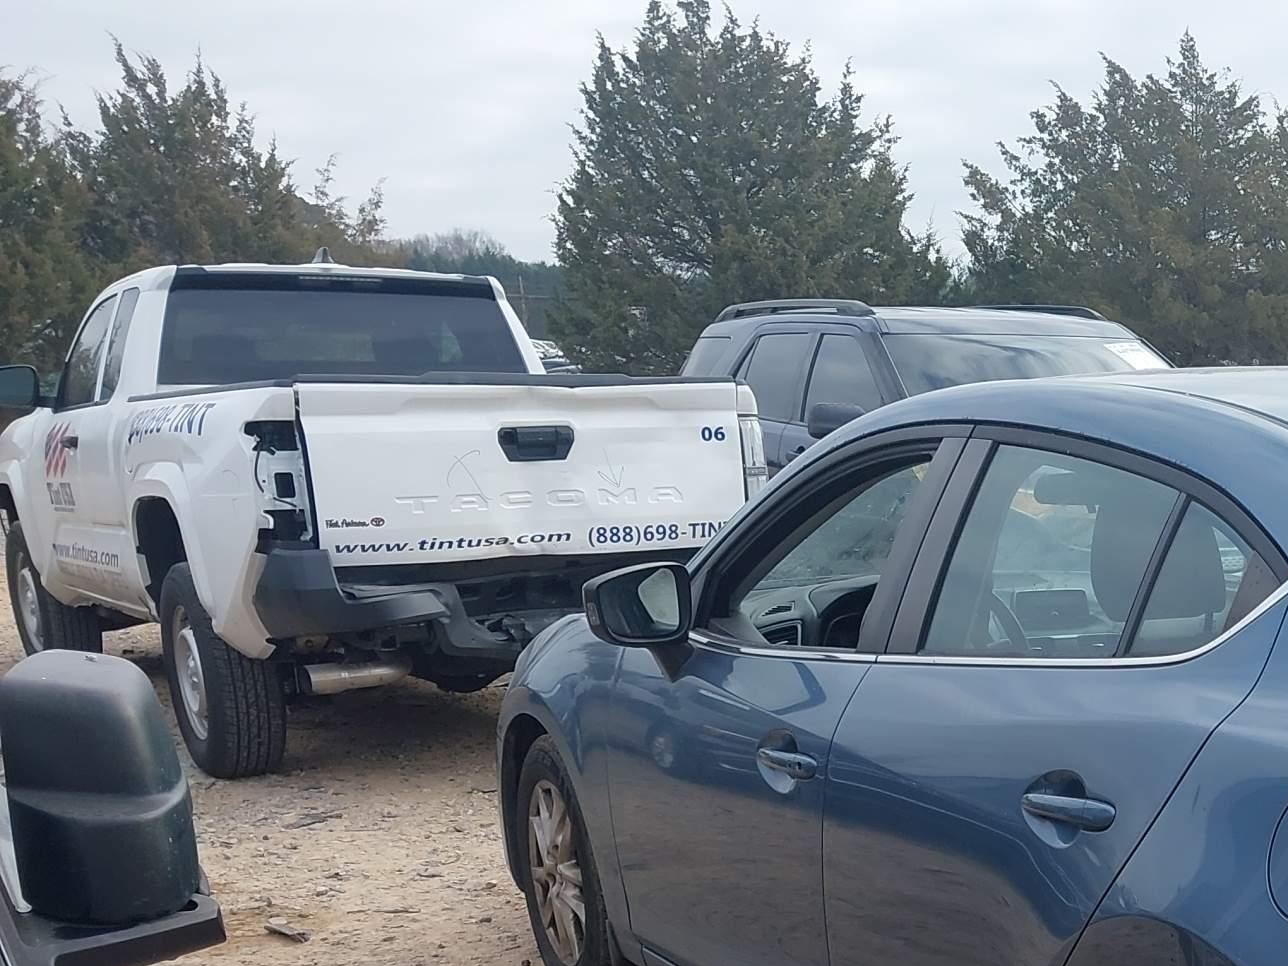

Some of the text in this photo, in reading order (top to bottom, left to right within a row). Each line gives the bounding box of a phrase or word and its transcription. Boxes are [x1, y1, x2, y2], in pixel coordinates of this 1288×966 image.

[701, 426, 726, 441] 06
[395, 486, 685, 514] TACOMA
[335, 521, 729, 554] www.tintusa.com (888)698-TIN
